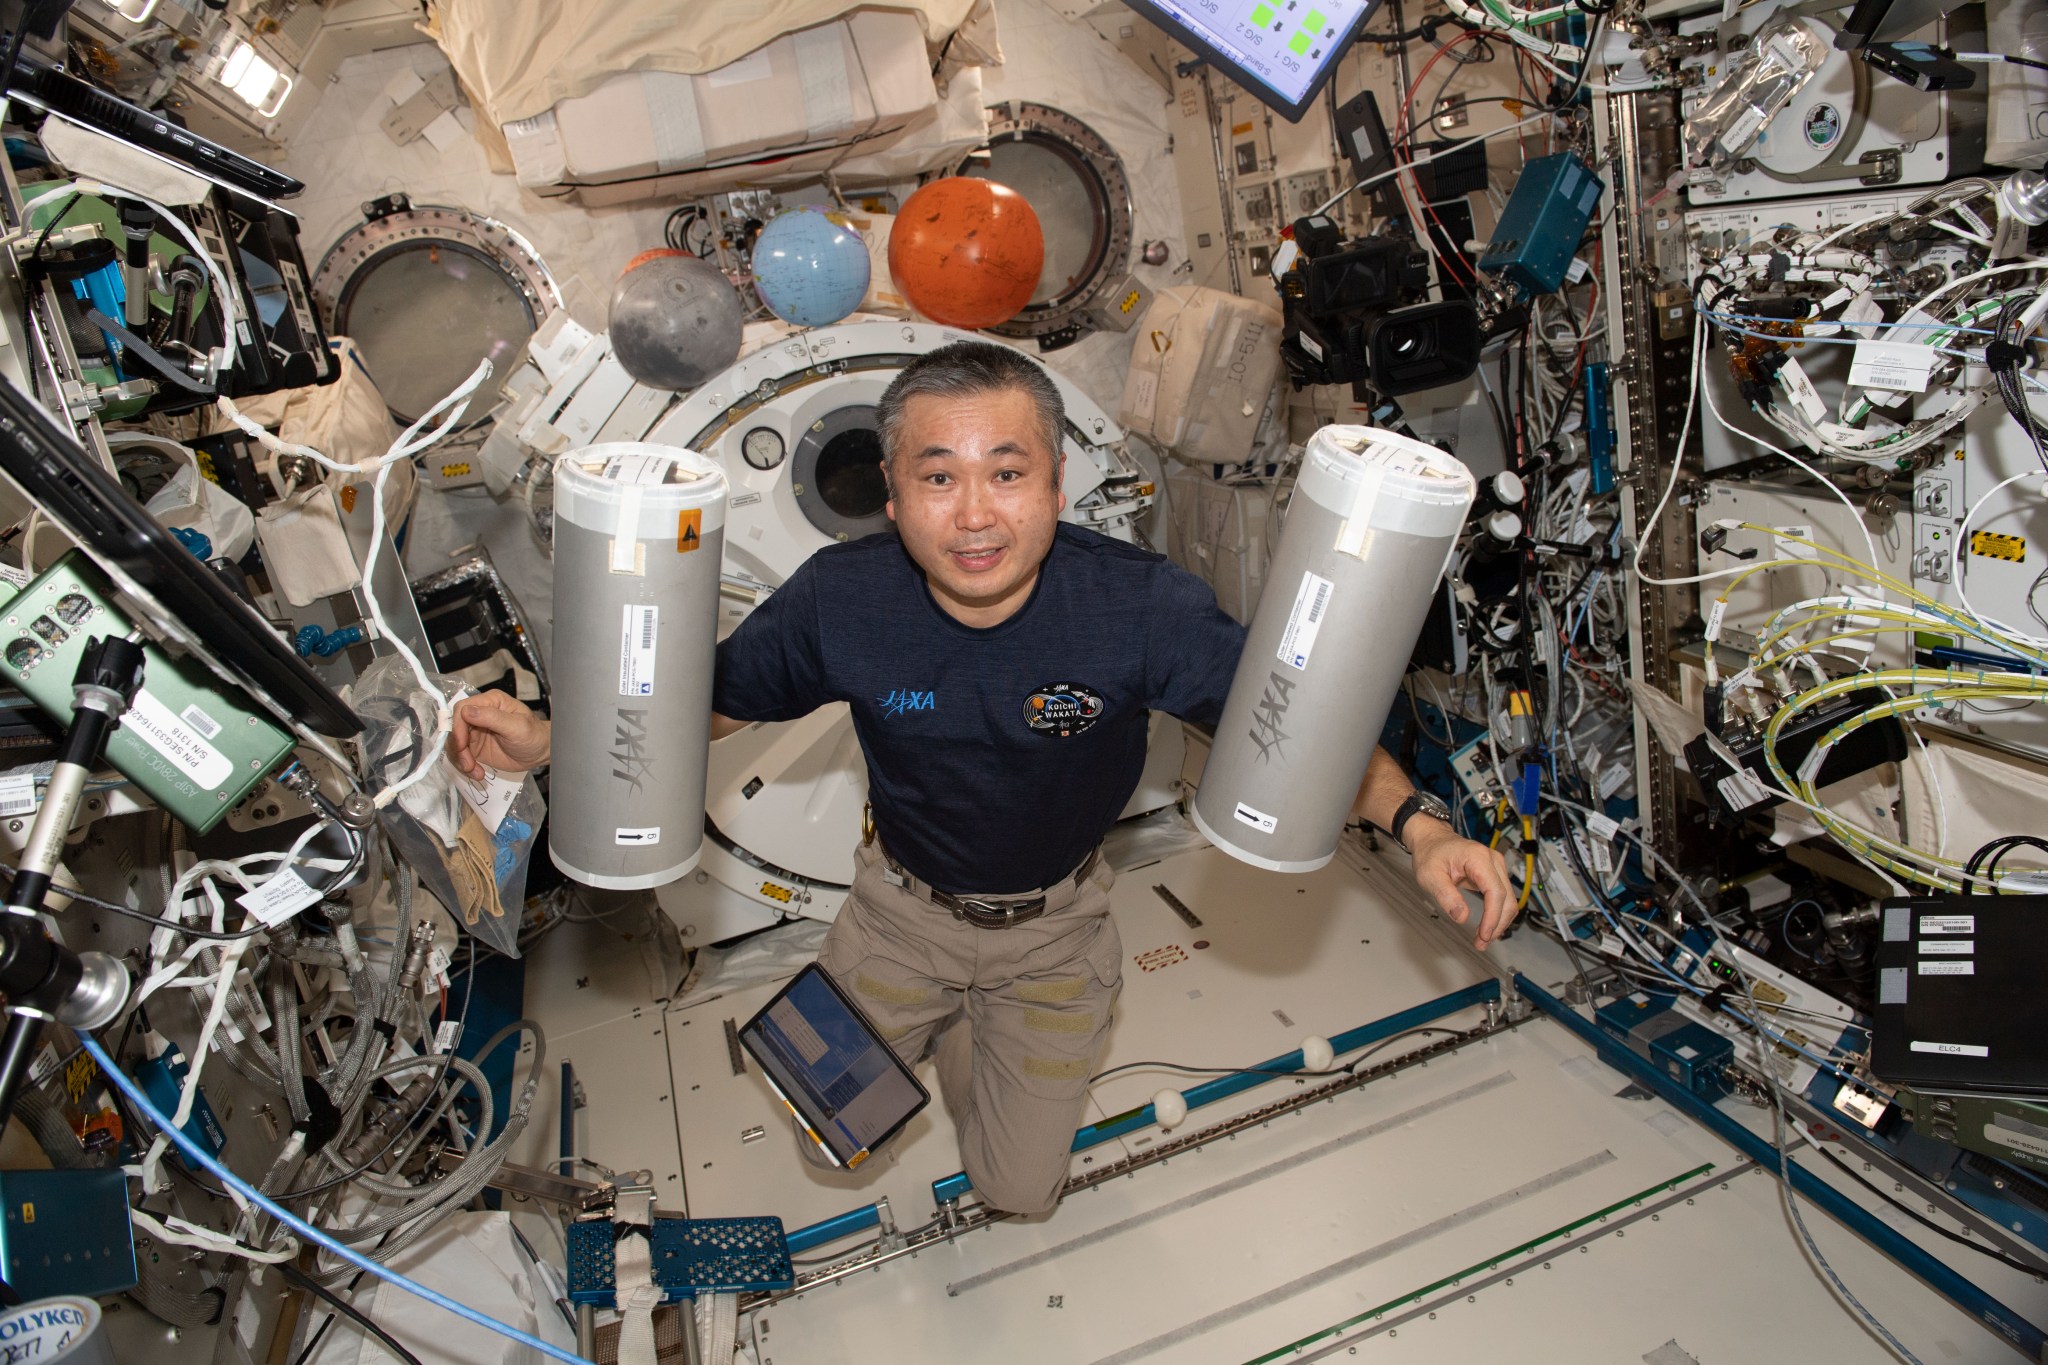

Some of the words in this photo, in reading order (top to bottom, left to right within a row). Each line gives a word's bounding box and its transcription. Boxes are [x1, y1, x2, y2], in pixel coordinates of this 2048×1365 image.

[1235, 22, 1245, 32] 2
[1242, 28, 1263, 46] S/G
[1244, 54, 1272, 76] S-Band
[1281, 54, 1301, 73] S/G
[1739, 115, 1755, 135] Tropical
[1726, 131, 1741, 145] Punch
[1053, 684, 1069, 694] JAXA
[876, 688, 935, 720] JAXA
[1048, 703, 1077, 711] KOICHI
[1045, 710, 1081, 718] WAKATA
[1249, 670, 1297, 768] JAXA
[171, 728, 191, 745] 1318
[125, 736, 149, 757] Power
[193, 745, 208, 760] S/N
[608, 708, 664, 798] JAXA
[184, 754, 199, 768] P/N
[146, 758, 179, 782] 28VDC
[1938, 1045, 1961, 1053] ELC4
[2011, 1150, 2034, 1164] Supply
